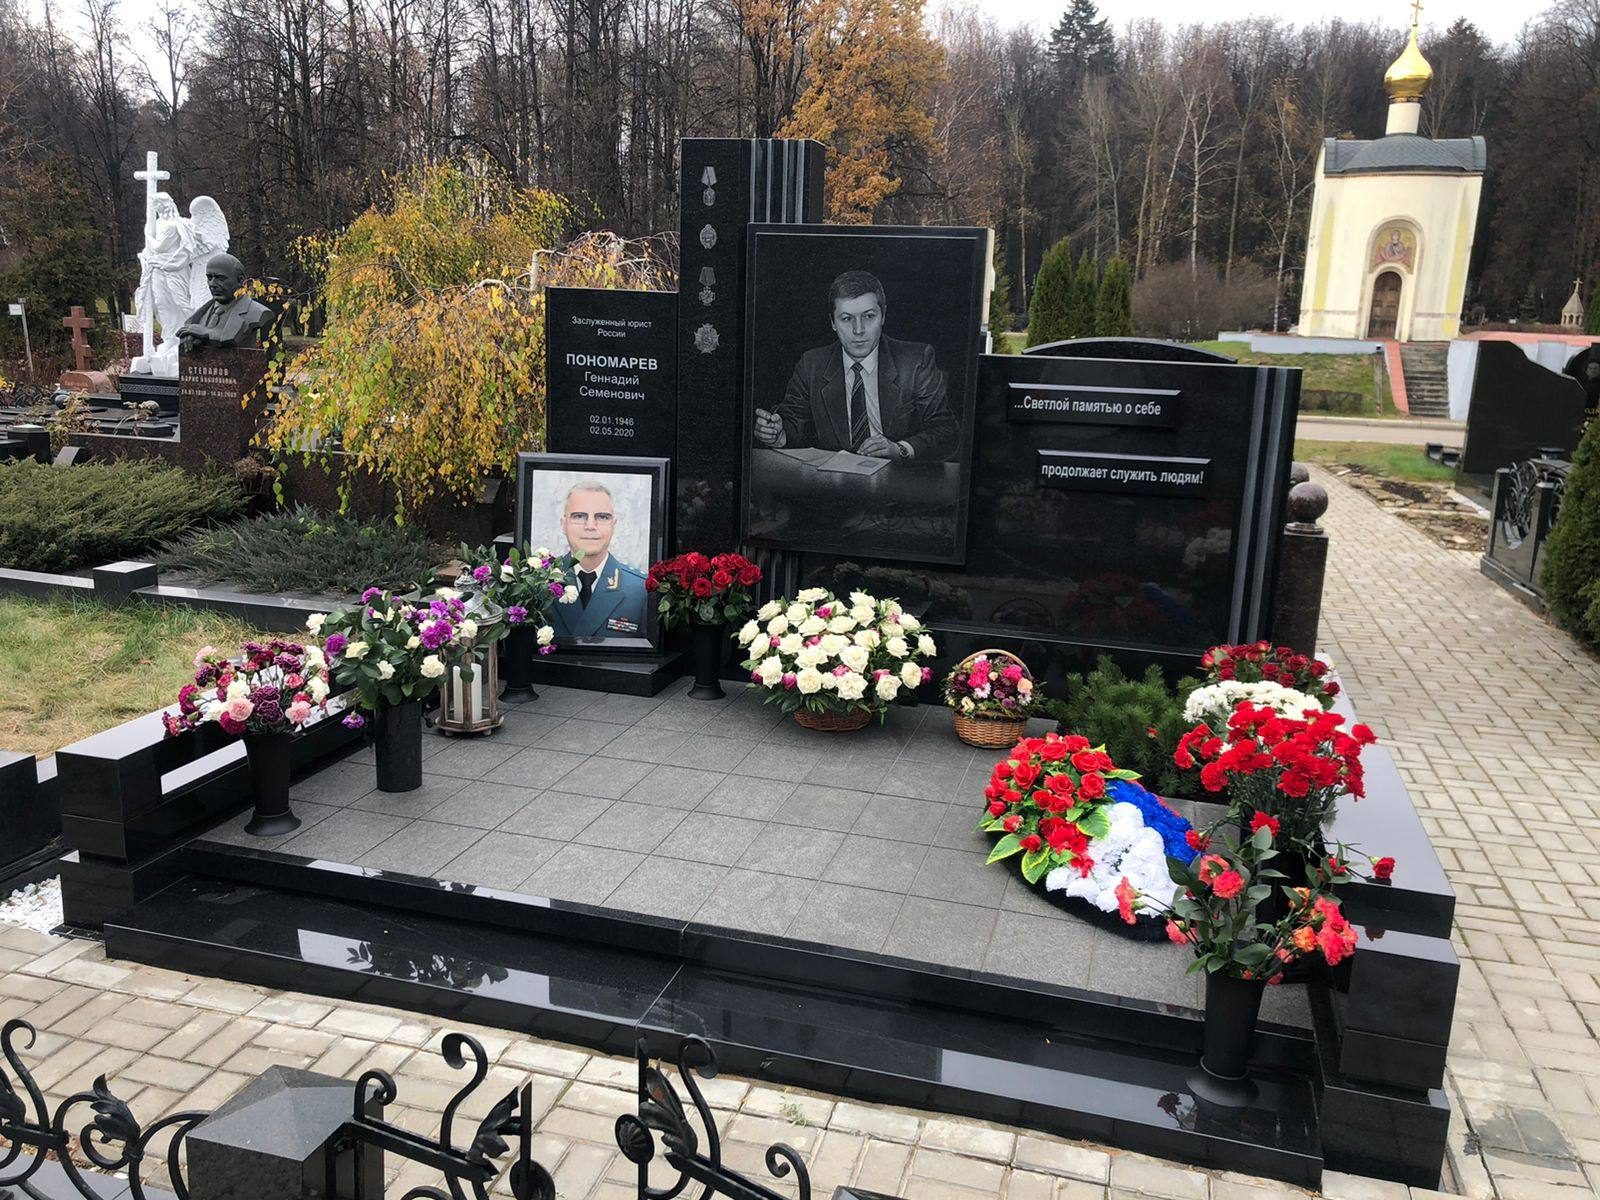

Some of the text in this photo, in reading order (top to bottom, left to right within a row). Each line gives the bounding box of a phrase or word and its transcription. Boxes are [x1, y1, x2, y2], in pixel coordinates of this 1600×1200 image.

[571, 315, 653, 329] Заслуженный юрист
[597, 328, 627, 338] России
[566, 353, 658, 370] ПОНОМАРЕВ
[584, 371, 640, 386] Геннадий
[579, 385, 645, 400] Семенович
[1072, 400, 1122, 414] памятью
[1125, 403, 1132, 414] о
[1135, 401, 1162, 416] себе
[589, 425, 635, 438] 02.05.2020
[1041, 464, 1204, 485] продолжает служить людям!
